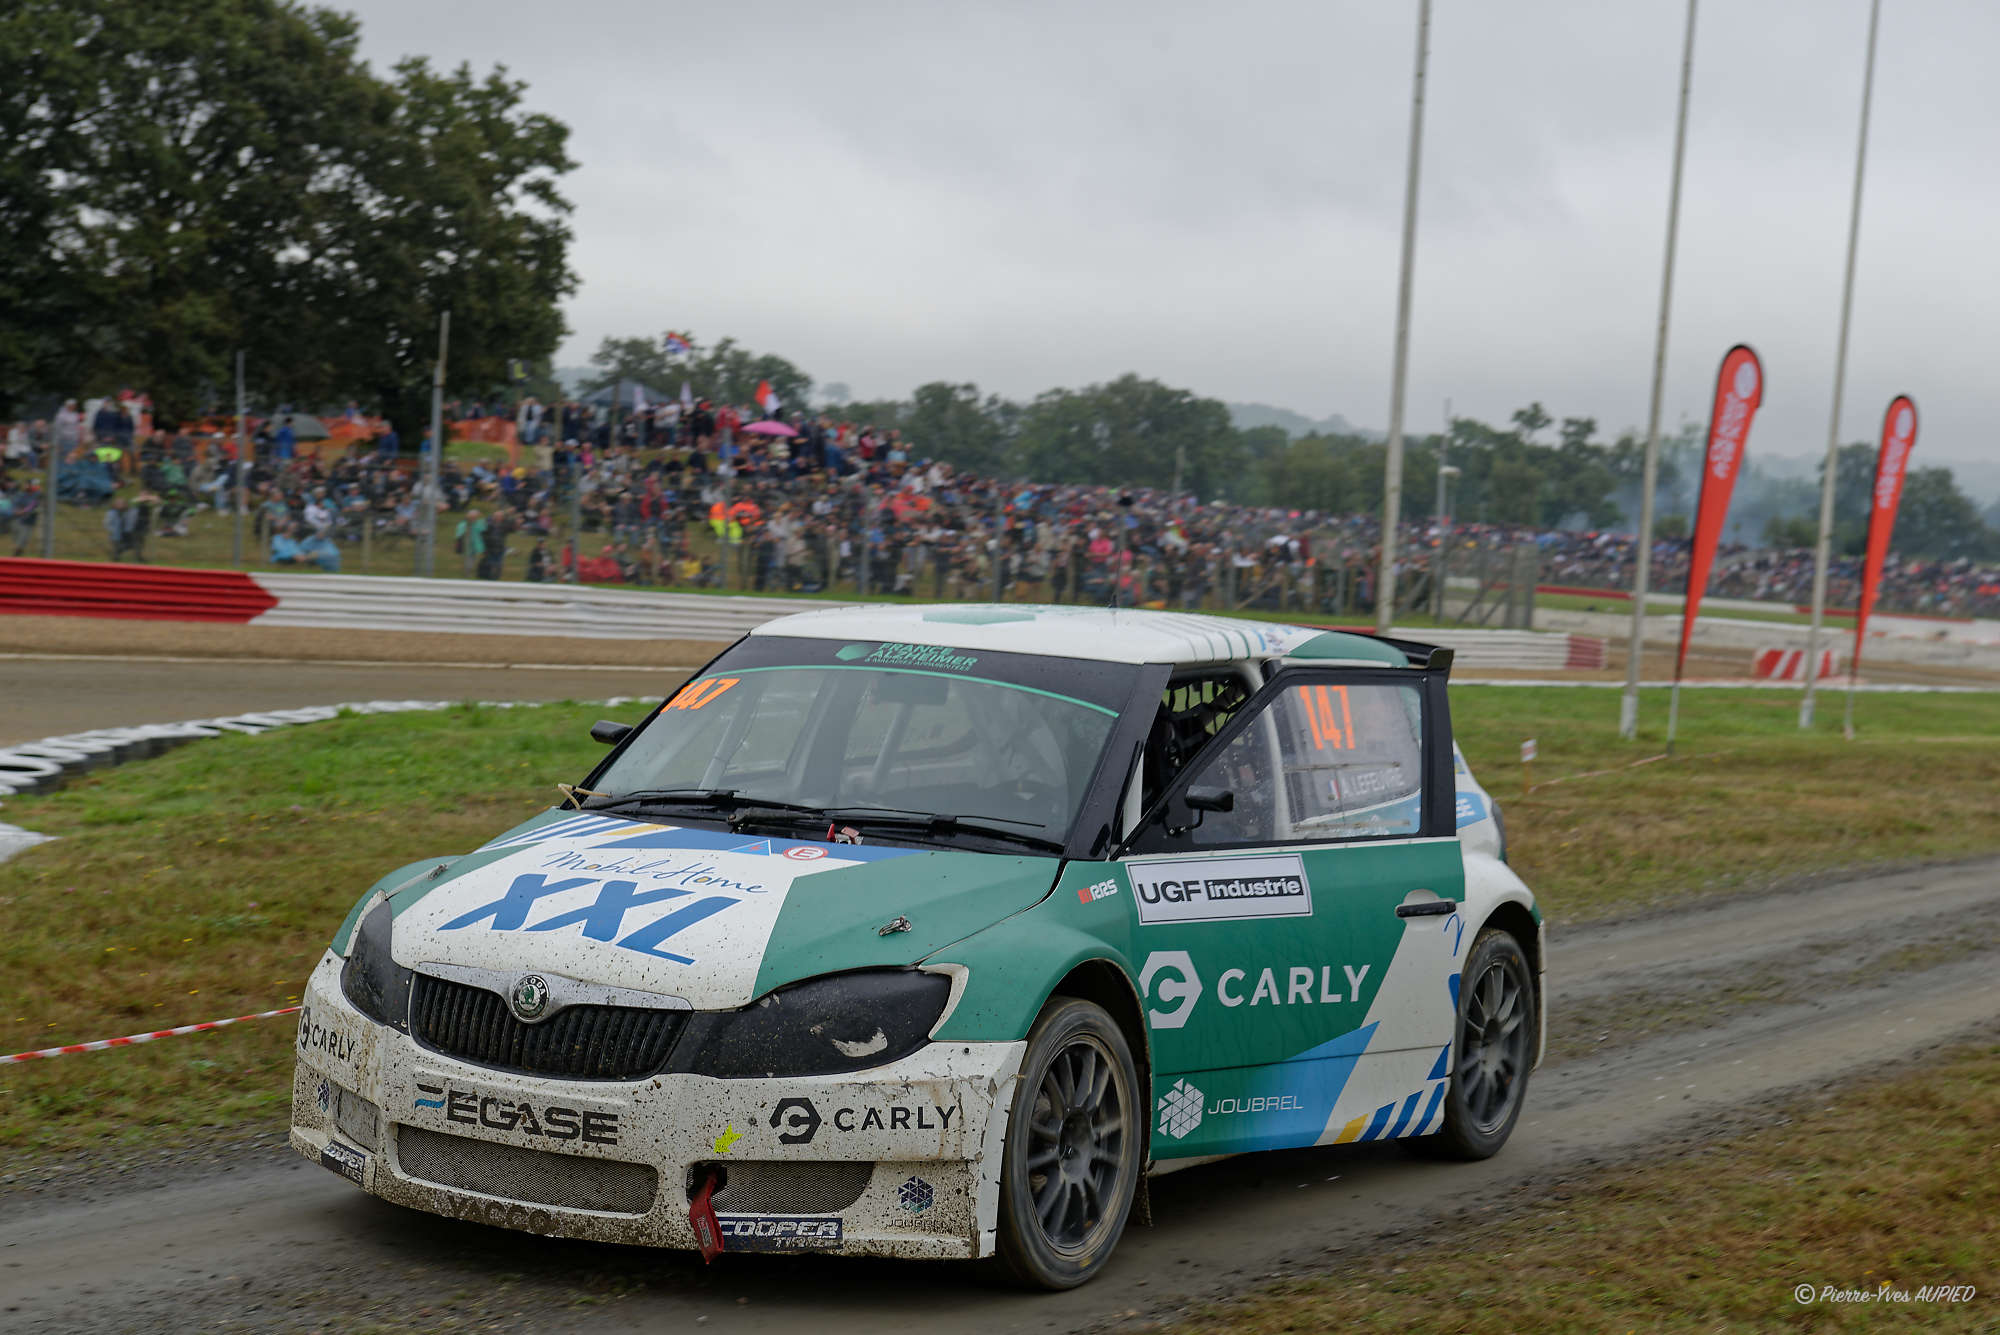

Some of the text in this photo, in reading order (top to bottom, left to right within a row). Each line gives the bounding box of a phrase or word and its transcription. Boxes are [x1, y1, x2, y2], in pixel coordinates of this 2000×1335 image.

[869, 648, 978, 667] ALZHEIMER
[878, 643, 956, 655] FRANCE
[660, 678, 740, 713] 147
[1299, 685, 1356, 750] 147
[540, 850, 769, 894] Mobil Home
[1091, 878, 1118, 901] RRS
[1138, 878, 1301, 904] UGF industrie
[436, 873, 743, 966] XXL
[1216, 964, 1371, 1007] CARLY
[312, 1024, 356, 1062] CARLY
[414, 1083, 619, 1145] PEGASE
[833, 1105, 957, 1132] CARLY
[1207, 1096, 1304, 1115] JOUBREL
[719, 1221, 840, 1238] COOPER
